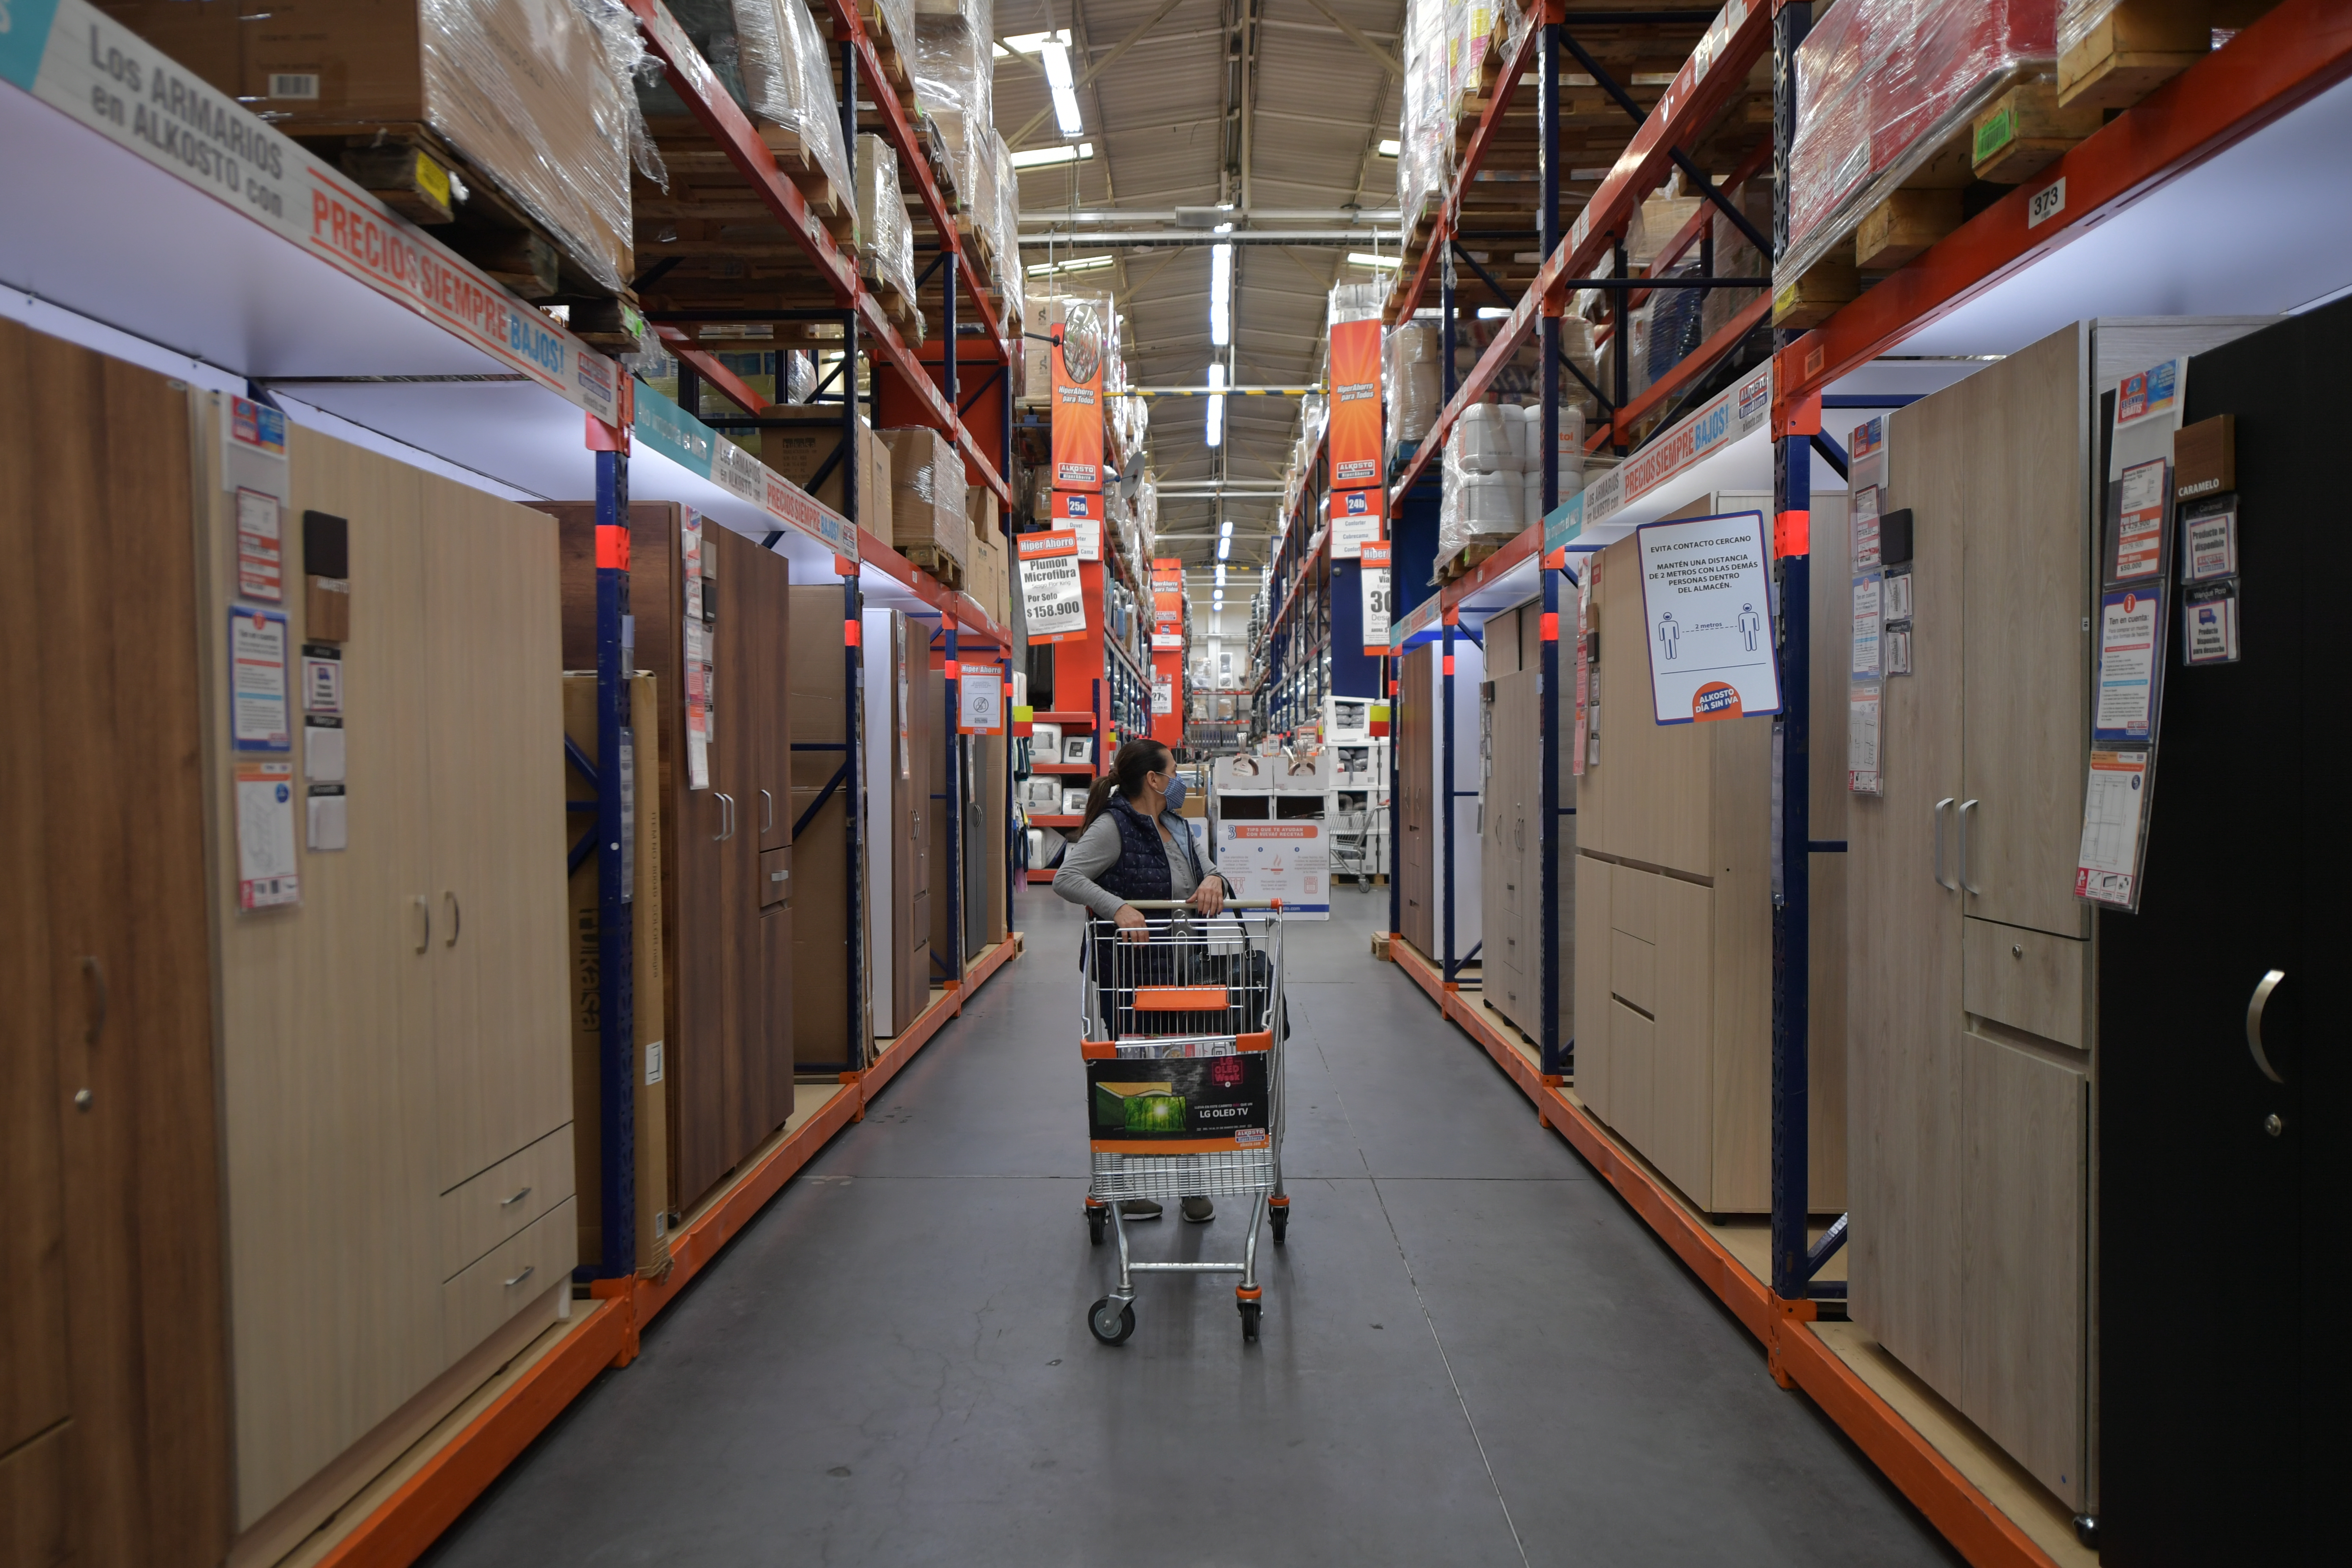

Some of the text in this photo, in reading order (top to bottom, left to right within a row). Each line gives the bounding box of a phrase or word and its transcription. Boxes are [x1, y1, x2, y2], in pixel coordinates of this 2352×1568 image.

[90, 24, 283, 180] Los ARMARIOS
[91, 84, 283, 219] en ALKOSTO con
[2034, 186, 2058, 215] 373
[312, 188, 565, 376] PRECIOS SIEMPRE BAJOS!
[1059, 386, 1094, 396] HiperAhorro
[1337, 384, 1373, 393] HiperAhorro
[1740, 375, 1767, 401] ALKOSTO
[1063, 395, 1094, 404] para Todos
[1341, 393, 1355, 402] para
[1625, 403, 1729, 498] PRECIOS SIEMPRE BAJOS!
[1062, 465, 1094, 474] ALKOSTO
[1340, 462, 1372, 471] ALKOSTO
[1595, 472, 1619, 503] ARMARIOS
[2178, 478, 2219, 497] CARAMELO
[767, 482, 794, 518] PRECIOS
[795, 498, 821, 533] SIEMPRE
[1069, 501, 1085, 512] 25a
[1348, 498, 1365, 509] 24b
[2192, 528, 2218, 540] Producto
[1045, 538, 1075, 549] Ahorro
[1650, 535, 1751, 553] EVITA CONTACTO CERCANO
[2195, 539, 2224, 552] disponible
[1030, 558, 1068, 571] Plumon
[1657, 553, 1748, 570] MANTÉN UNA DISTANCIA
[1024, 569, 1076, 583] Microfibra
[1666, 568, 1697, 578] METROS
[1698, 566, 1714, 574] CON
[1715, 564, 1730, 573] LAS
[1731, 561, 1758, 571] DEMÁS
[1668, 572, 1740, 586] PERSONAS DENTRO
[1693, 582, 1732, 592] ALMACÉN.
[1027, 593, 1058, 603] Por Solo
[1033, 601, 1080, 618] 158.900
[2128, 614, 2150, 622] cuenta:
[1699, 688, 1734, 704] ALKOSTO
[1695, 695, 1739, 713] DÍA SIN IVA
[1220, 1056, 1233, 1065] LG
[1215, 1064, 1239, 1074] OLED
[1215, 1073, 1240, 1082] Week
[1200, 1108, 1249, 1118] LG OLED TV
